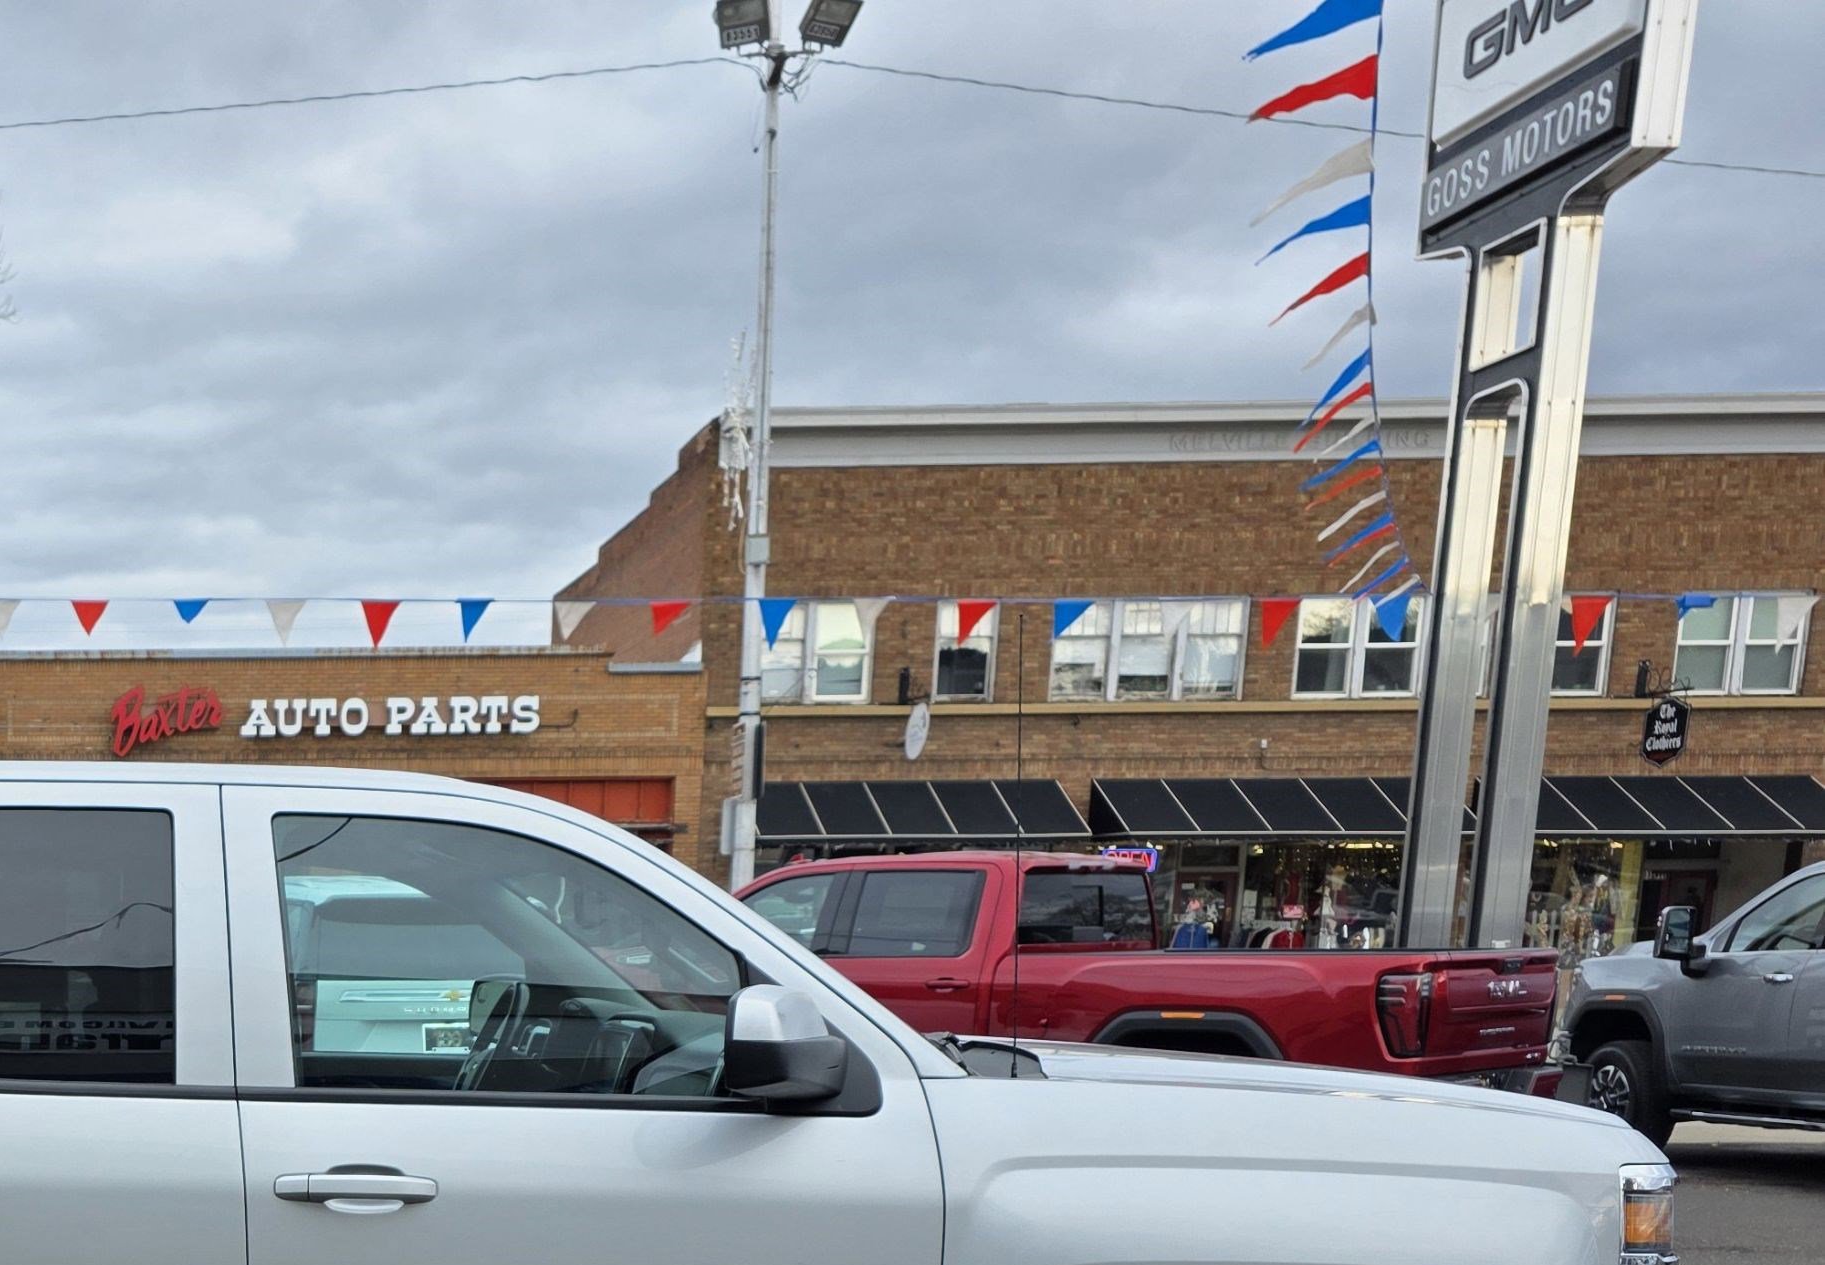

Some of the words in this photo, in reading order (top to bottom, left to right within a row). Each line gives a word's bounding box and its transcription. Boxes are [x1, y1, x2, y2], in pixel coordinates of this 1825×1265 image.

[1427, 149, 1490, 217] GOSS
[1500, 79, 1614, 177] MOTORS
[110, 683, 224, 758] Baxter
[240, 698, 369, 738] AUTO
[384, 694, 541, 737] PARTS
